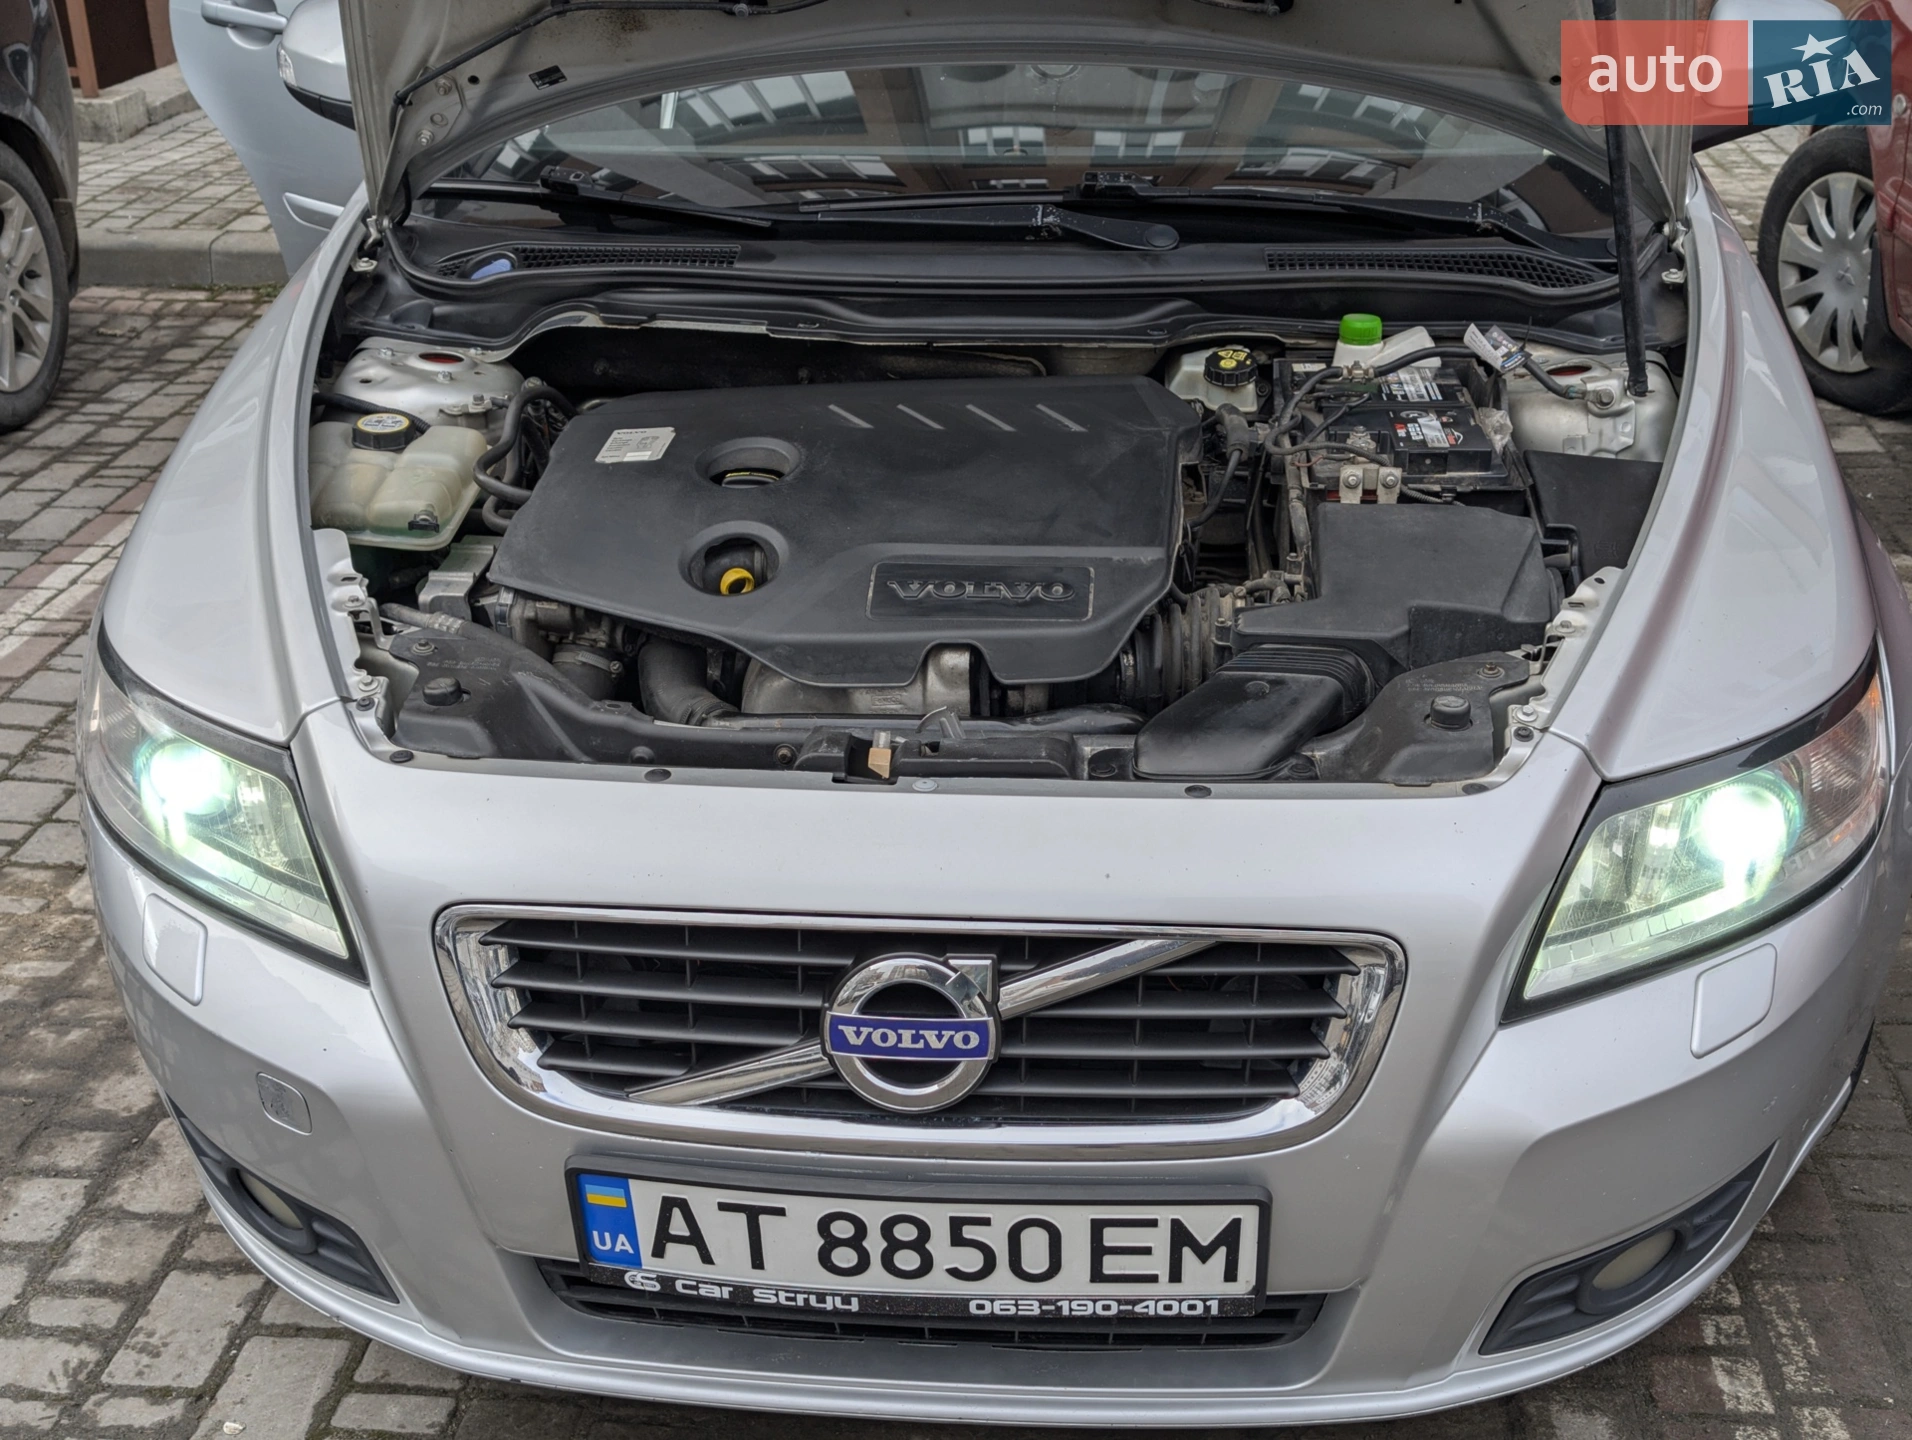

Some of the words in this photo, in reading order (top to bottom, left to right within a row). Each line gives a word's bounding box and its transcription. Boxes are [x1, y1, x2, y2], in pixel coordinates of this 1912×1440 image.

[887, 579, 1076, 602] VOLVO
[837, 1025, 980, 1050] VOLVO
[592, 1230, 634, 1254] UA
[650, 1195, 787, 1271] AT
[816, 1210, 1062, 1283] 8850
[1089, 1217, 1243, 1283] EM
[968, 1299, 1219, 1316] 063-190-4001
